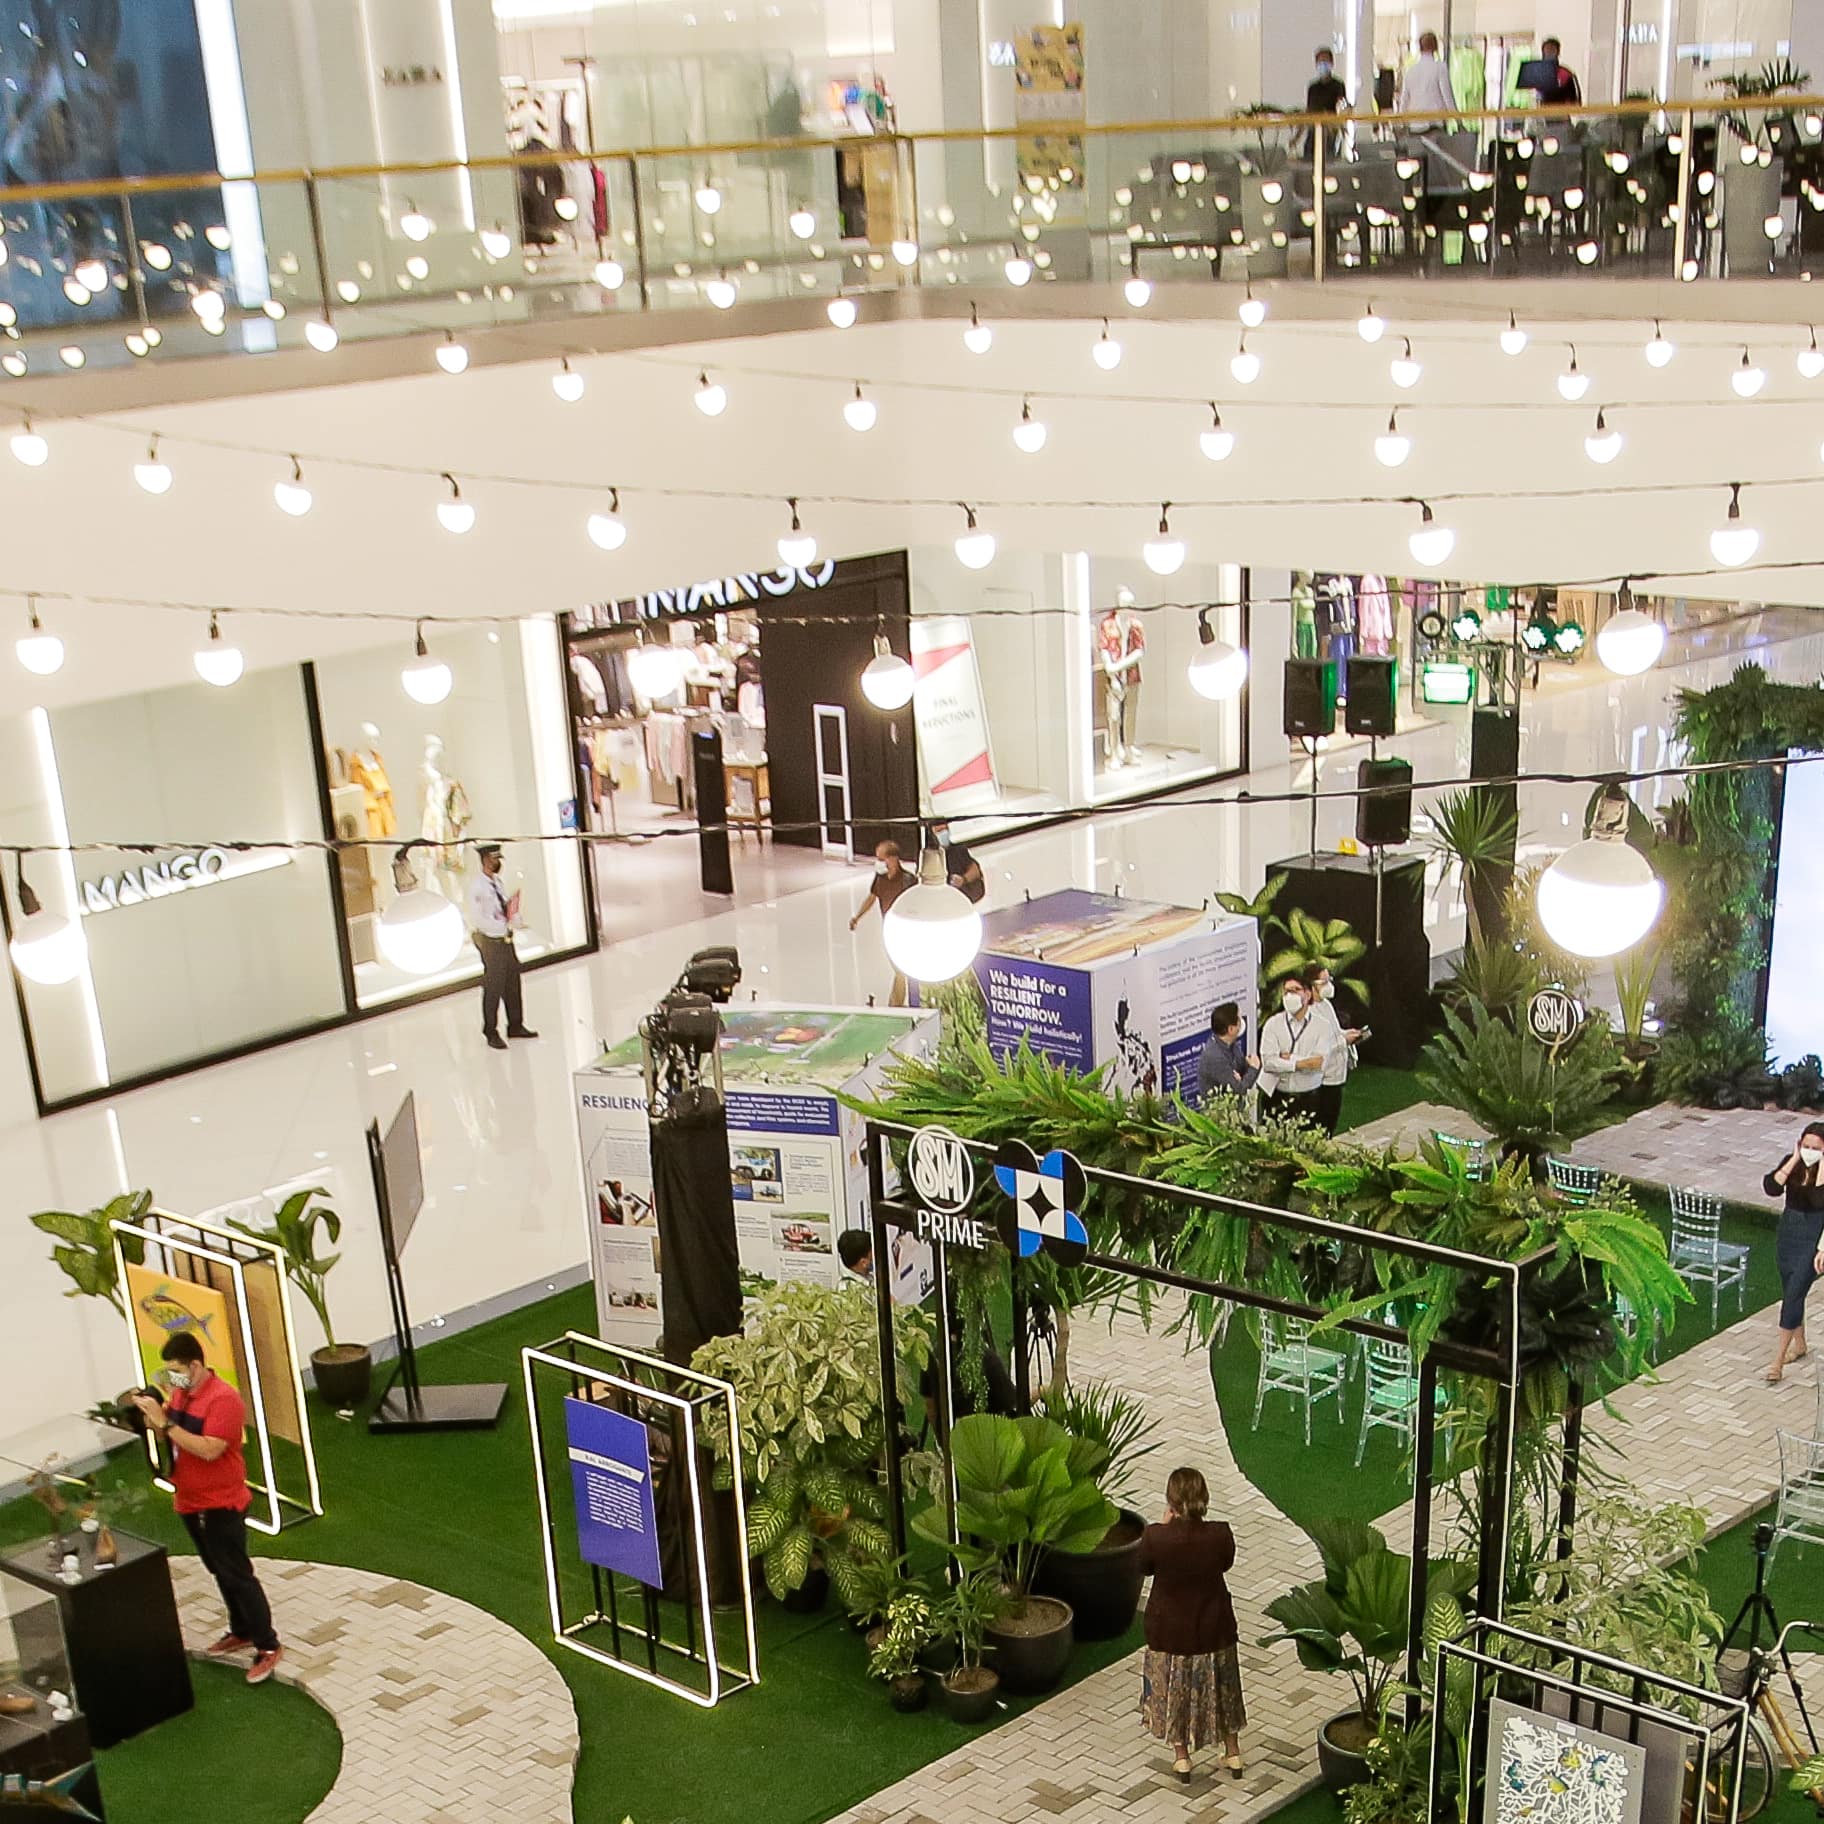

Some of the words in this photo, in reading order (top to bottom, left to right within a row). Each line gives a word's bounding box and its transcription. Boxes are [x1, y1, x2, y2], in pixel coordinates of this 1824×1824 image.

[82, 848, 227, 912] MANGO
[989, 969, 1009, 986] We
[1010, 973, 1038, 991] build
[1039, 978, 1057, 994] for
[1058, 985, 1067, 997] a
[990, 985, 1042, 1007] RESILIENT
[990, 1000, 1063, 1026] TOMORROW.
[1534, 994, 1568, 1034] SM
[915, 1131, 964, 1203] SM
[917, 1209, 985, 1250] PRIME
